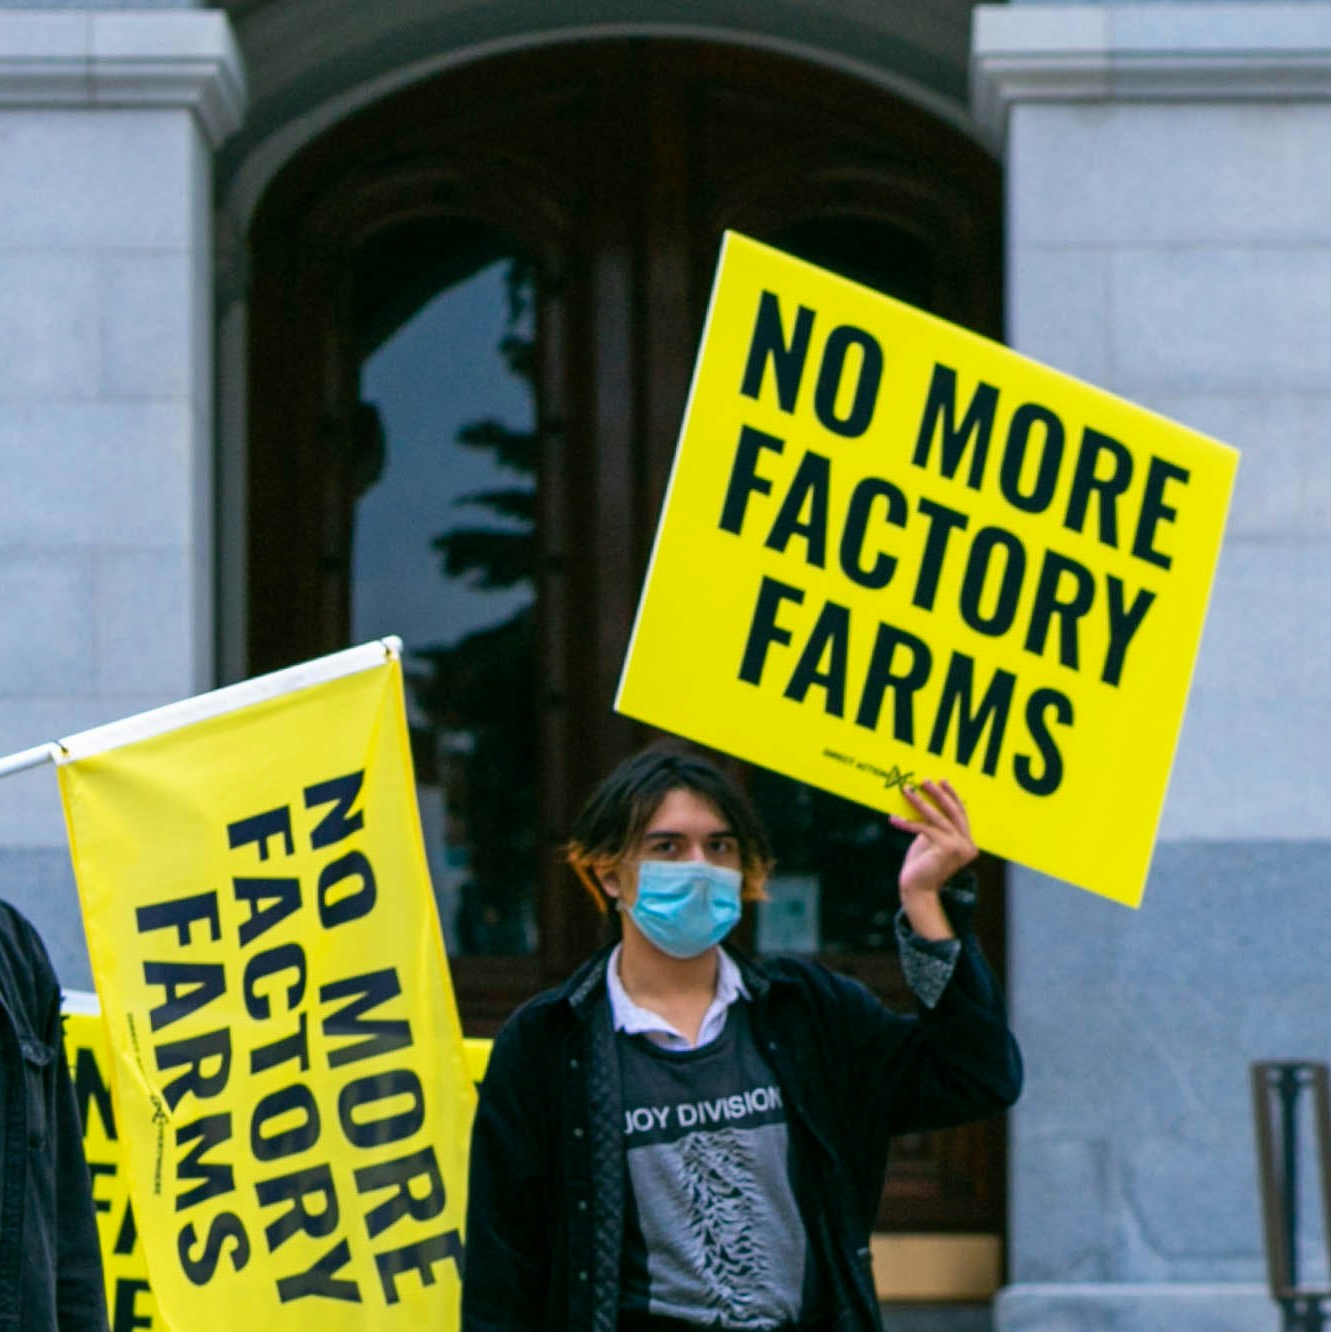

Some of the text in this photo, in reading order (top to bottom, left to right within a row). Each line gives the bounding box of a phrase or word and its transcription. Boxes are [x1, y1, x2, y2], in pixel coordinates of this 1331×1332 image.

[718, 424, 1157, 688] FACTORY
[740, 289, 1191, 571] NO MORE
[738, 575, 1074, 796] FARMS
[303, 769, 378, 930] NO
[135, 890, 252, 1287] FARMS
[226, 805, 363, 1305] FACTORY
[318, 966, 464, 1306] MORE
[624, 1085, 783, 1134] JOY DIVISION
